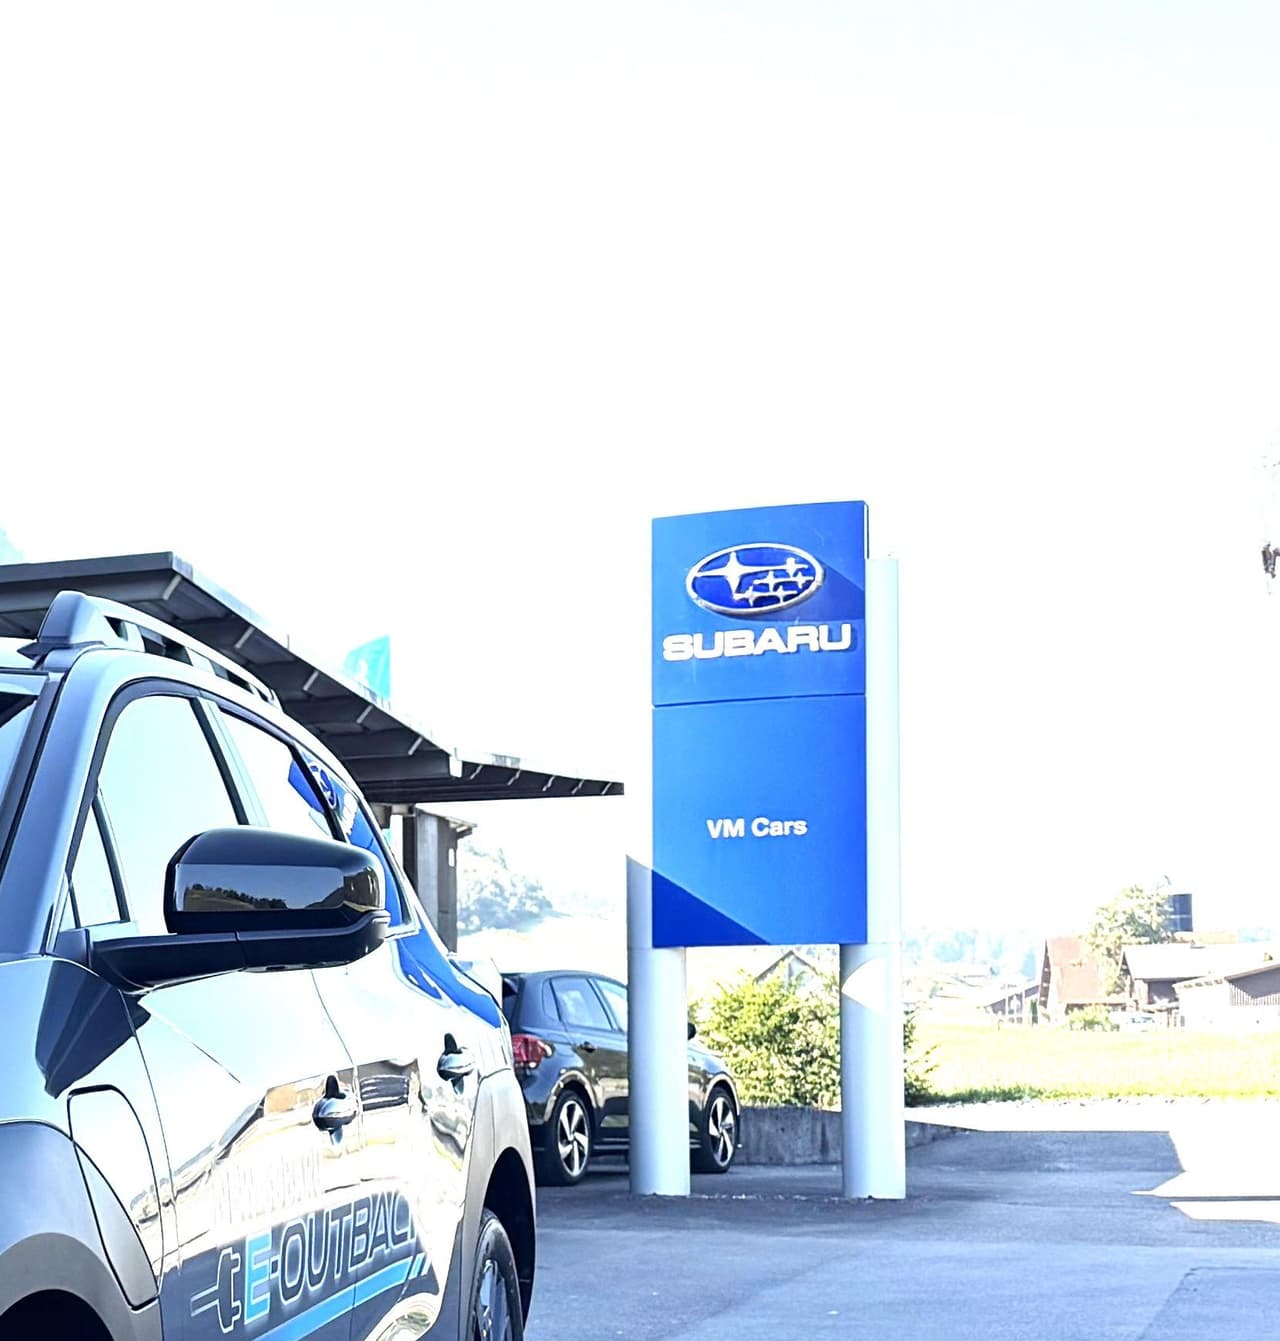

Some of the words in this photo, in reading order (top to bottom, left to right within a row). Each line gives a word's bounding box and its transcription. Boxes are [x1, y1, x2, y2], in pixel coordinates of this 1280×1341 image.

[662, 623, 851, 662] SUBARU
[706, 819, 745, 839] VM
[753, 816, 808, 838] Cars
